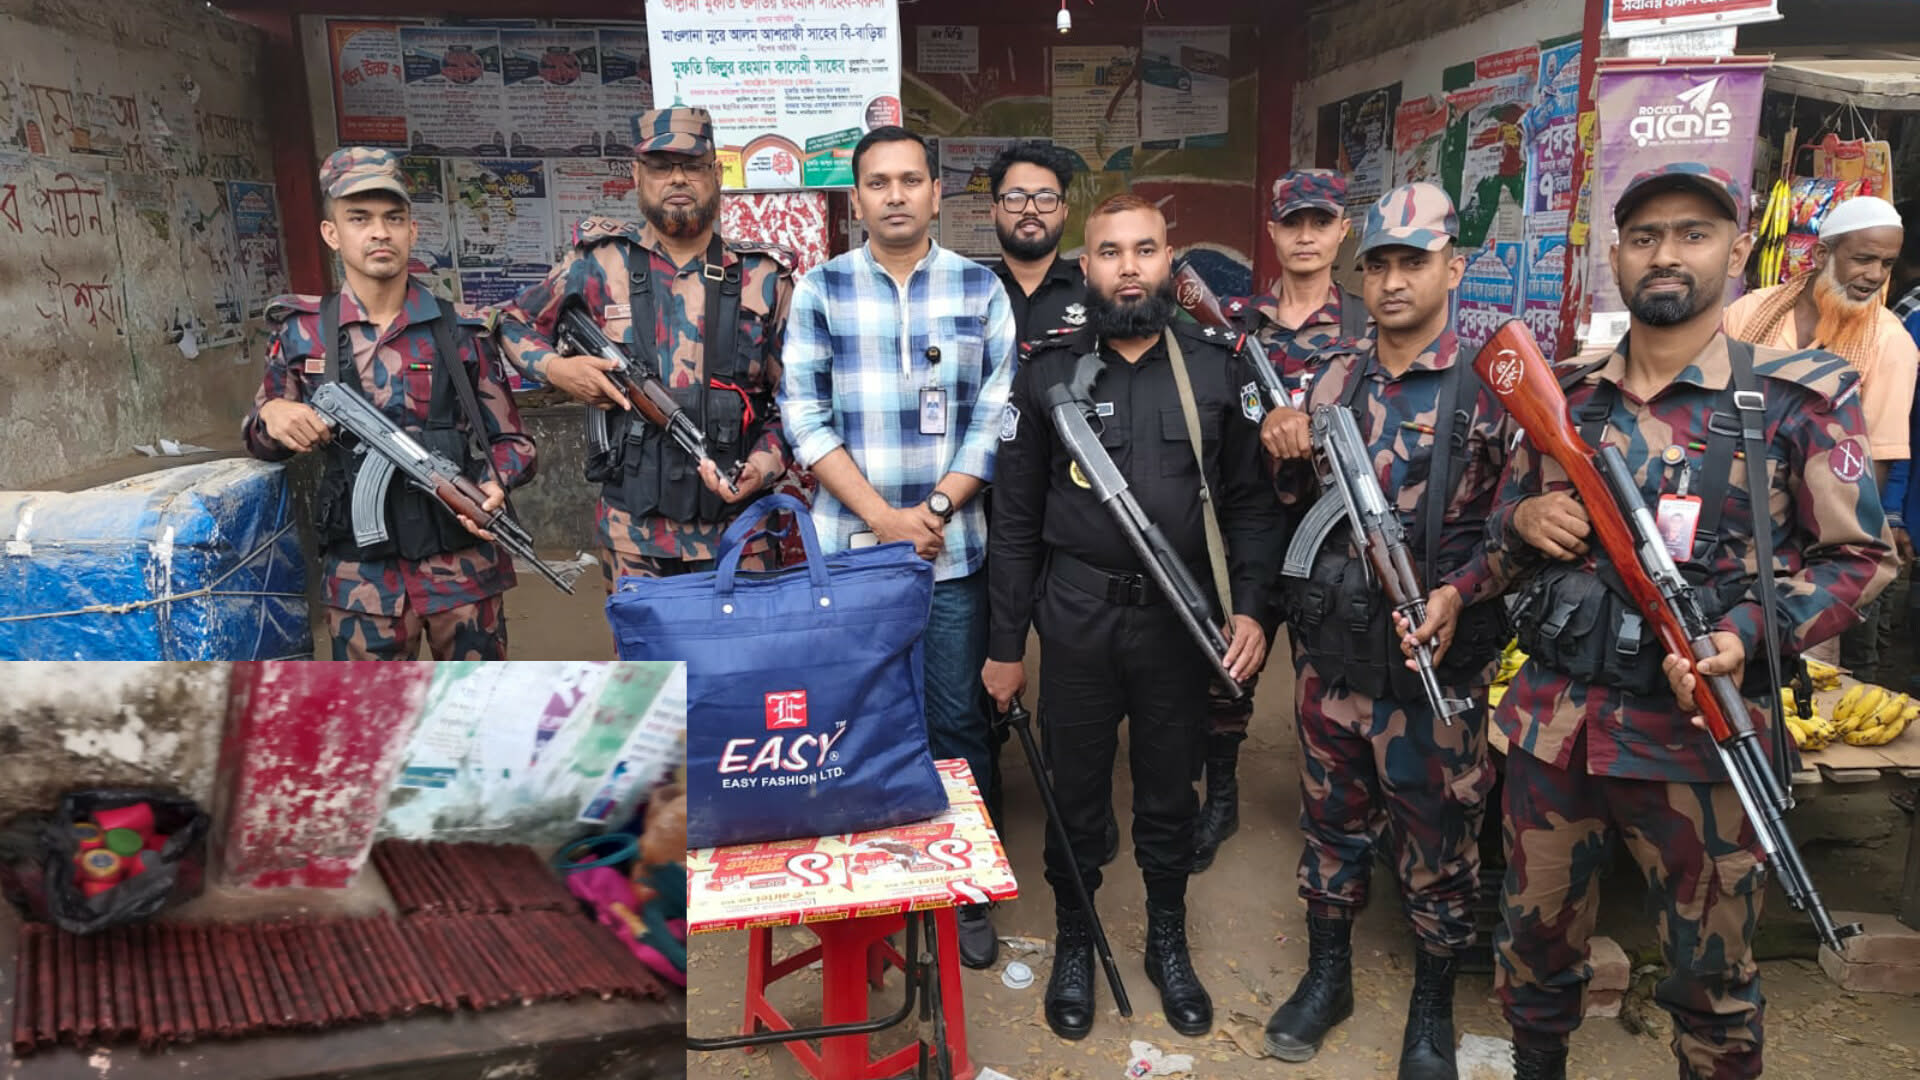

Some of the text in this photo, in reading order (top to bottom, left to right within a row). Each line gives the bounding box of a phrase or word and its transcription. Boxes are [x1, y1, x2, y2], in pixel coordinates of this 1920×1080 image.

[661, 29, 702, 42] মাওলানা
[728, 29, 758, 42] আলম
[807, 28, 837, 42] সাহেব
[672, 56, 702, 79] মুফতি
[738, 59, 770, 76] রহমান
[775, 54, 811, 75] কাসেমী
[815, 59, 845, 75] সাহেব
[1639, 105, 1684, 116] ROCKET
[1629, 102, 1733, 148] রকেট
[718, 727, 846, 774] EASY
[722, 767, 846, 789] EASY FASHION LTD.
